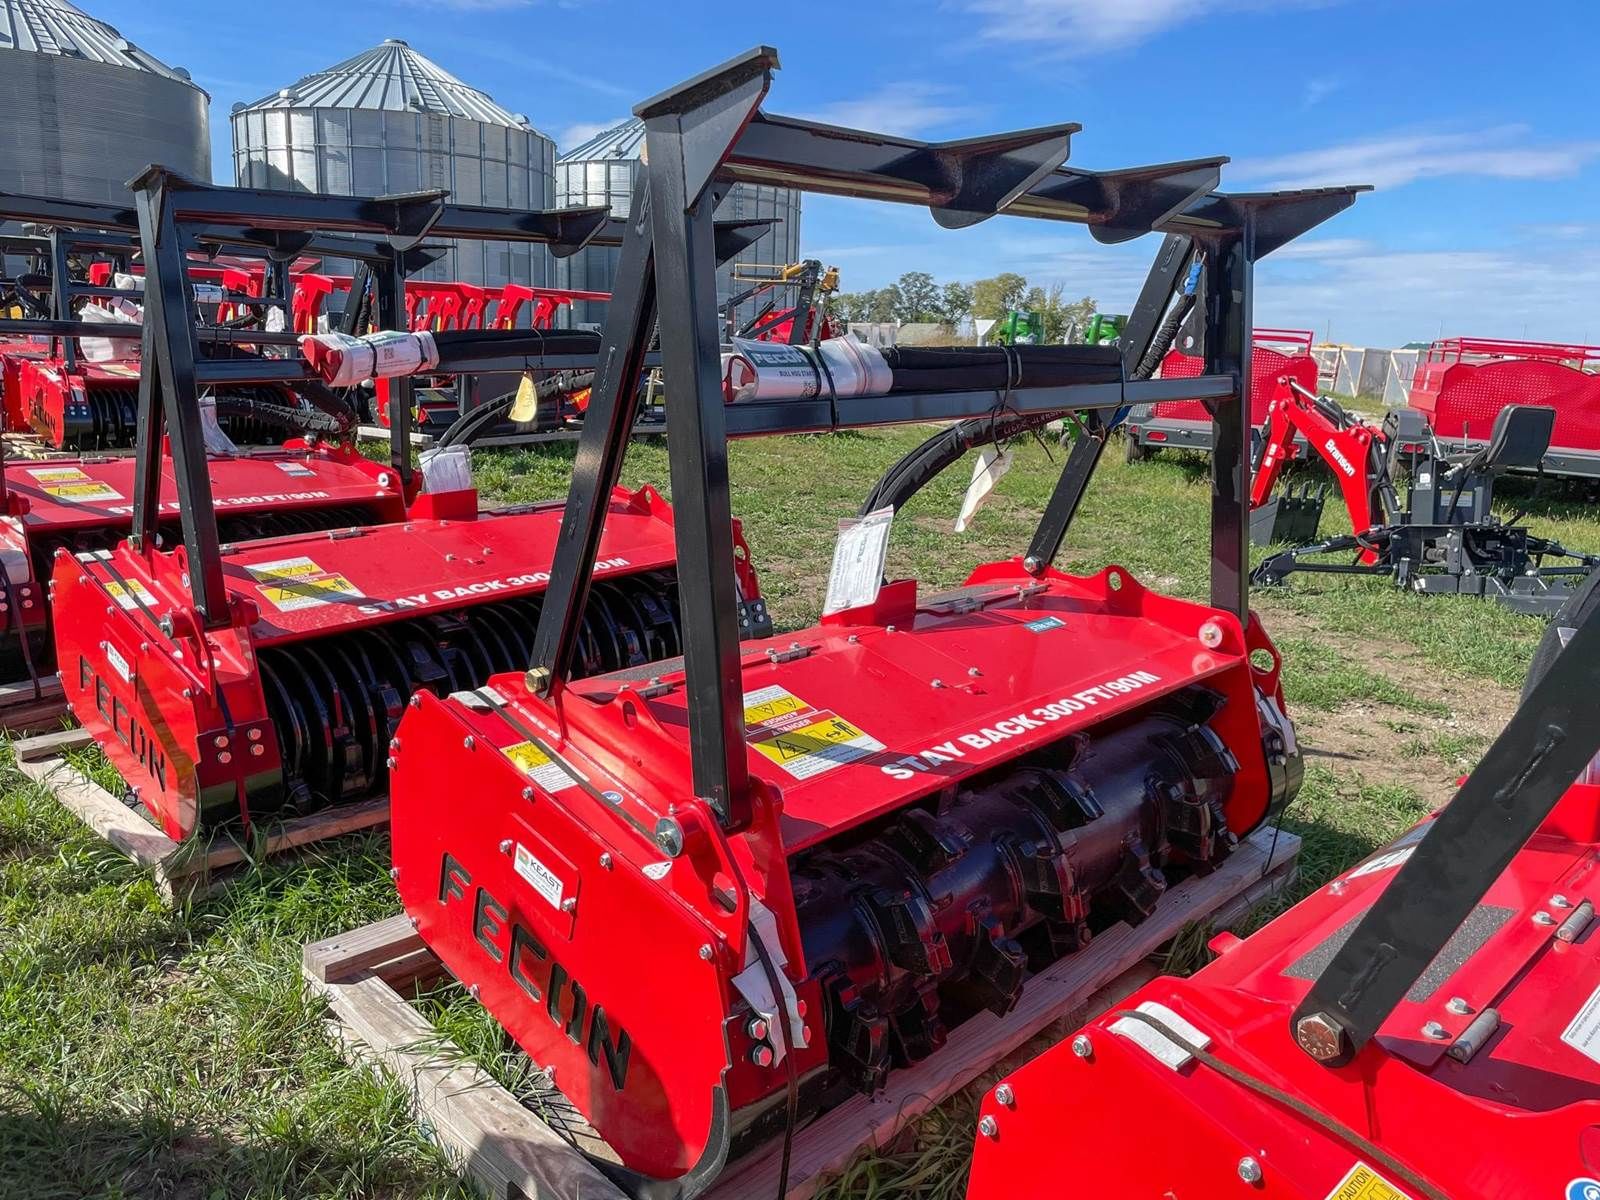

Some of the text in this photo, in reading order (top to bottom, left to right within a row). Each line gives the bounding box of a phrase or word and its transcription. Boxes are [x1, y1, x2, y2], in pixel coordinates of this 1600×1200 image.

[1325, 438, 1356, 477] Branson
[357, 593, 436, 615] STAY
[432, 579, 504, 601] BACK
[506, 571, 550, 587] 300
[881, 740, 966, 780] STAY
[958, 713, 1047, 751] BACK
[530, 858, 562, 891] KEAST
[438, 851, 633, 1093] FECON
